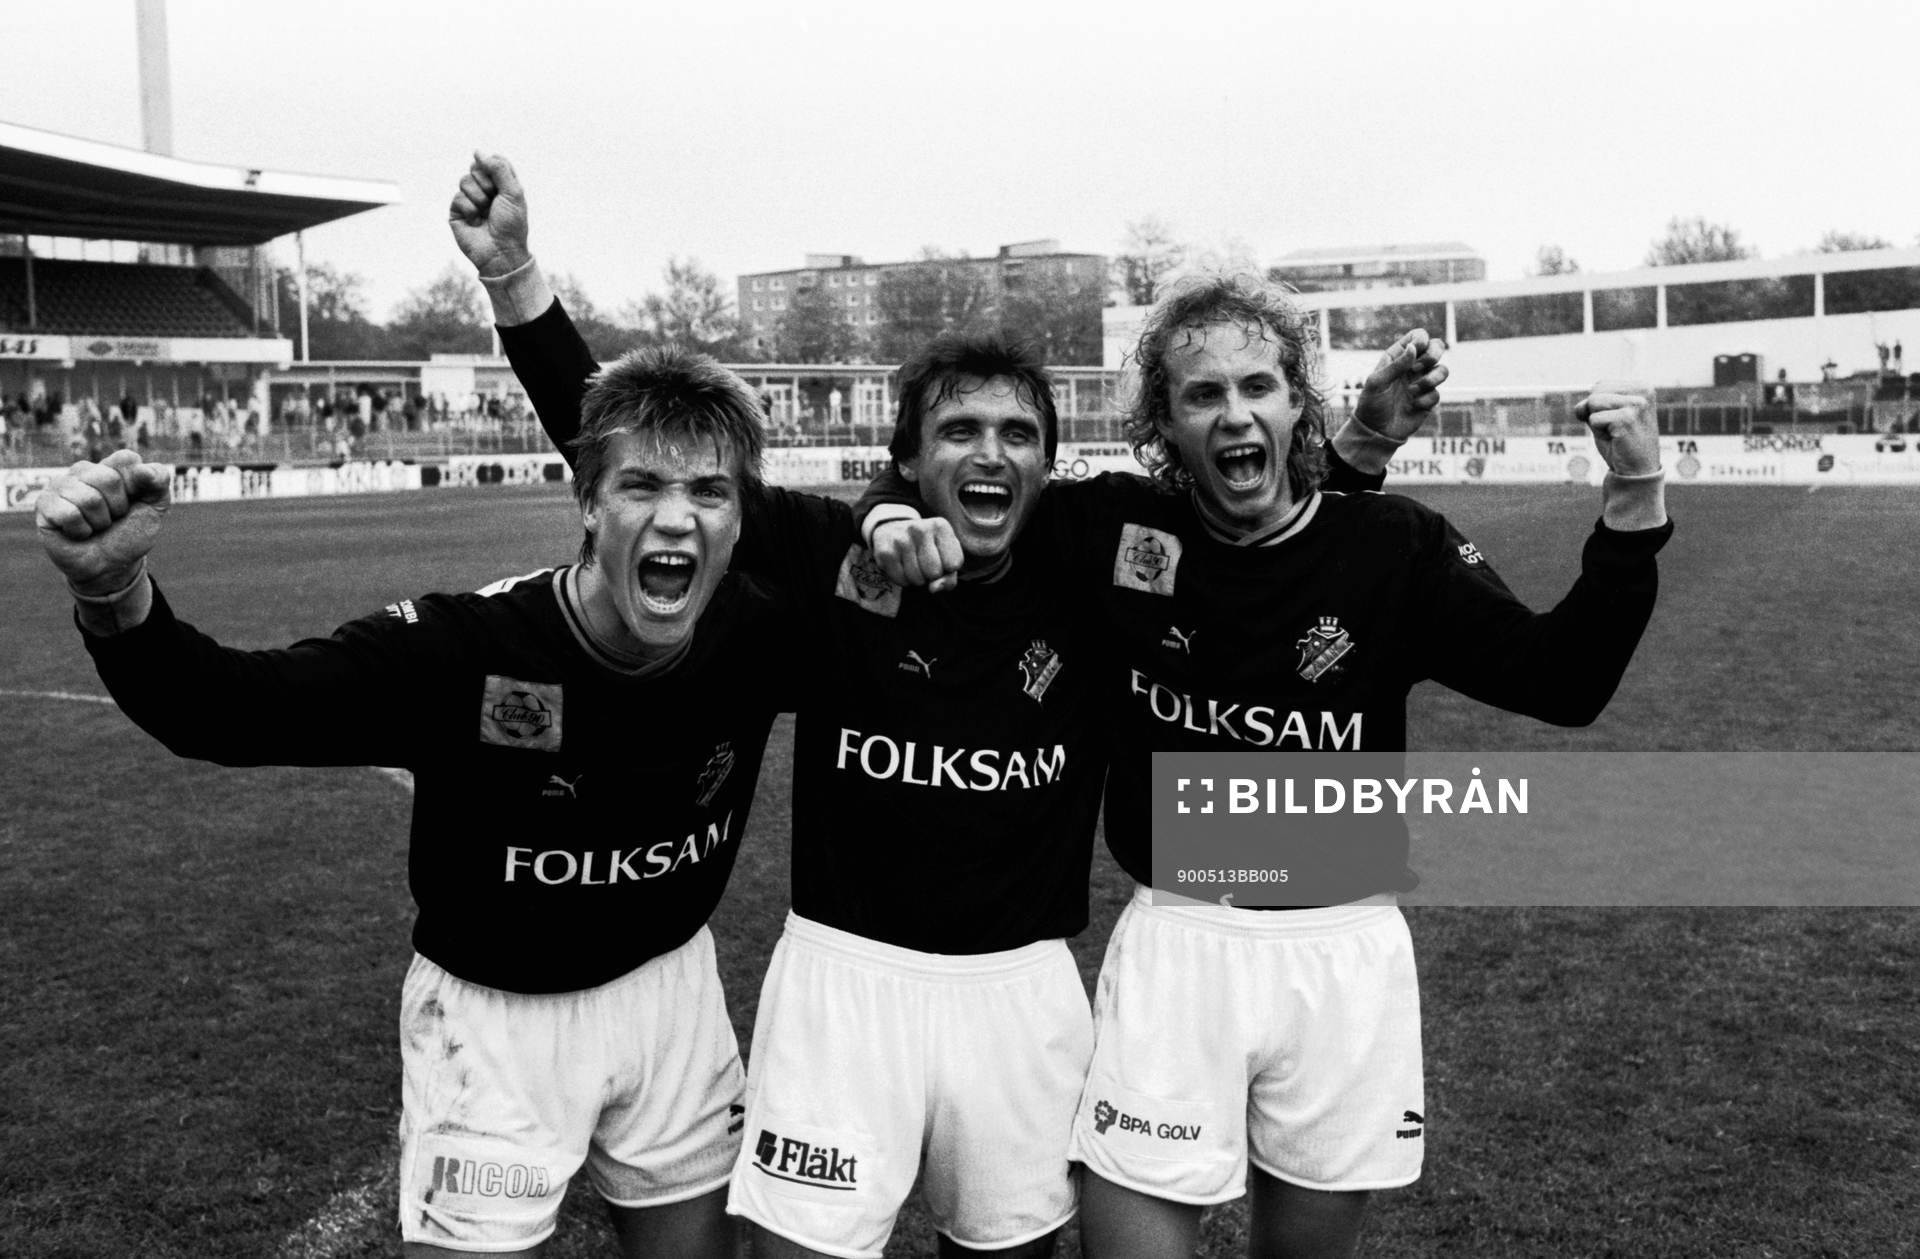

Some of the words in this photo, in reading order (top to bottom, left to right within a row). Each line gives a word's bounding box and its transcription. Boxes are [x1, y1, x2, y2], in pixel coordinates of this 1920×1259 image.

[1131, 668, 1363, 751] FOLKSAM
[837, 727, 1066, 791] FOLKSAM
[504, 810, 733, 885] FOLKSAM
[1119, 1113, 1152, 1136] BPA
[1157, 1123, 1201, 1141] GOLV
[432, 1156, 550, 1198] RICOH
[777, 1137, 857, 1183] Fläkt
